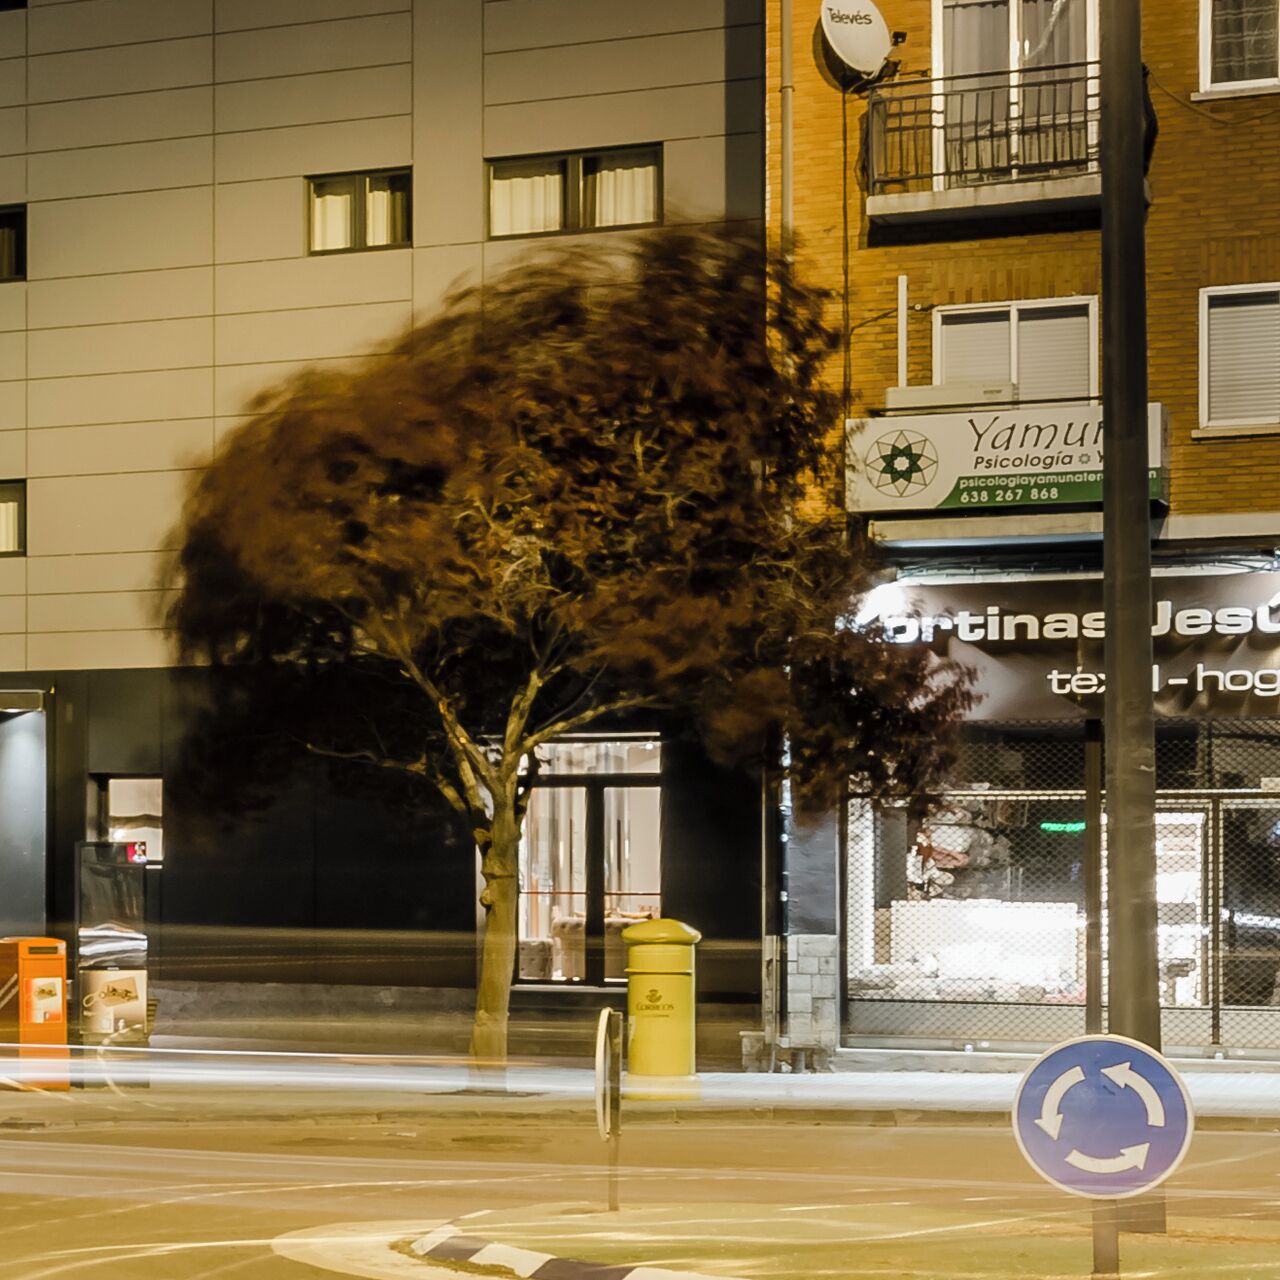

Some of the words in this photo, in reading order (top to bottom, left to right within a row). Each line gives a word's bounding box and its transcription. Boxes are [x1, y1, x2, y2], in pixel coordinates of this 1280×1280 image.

[826, 7, 873, 25] Televés
[973, 450, 1074, 470] Psicología
[960, 490, 989, 503] 638
[995, 489, 1023, 502] 267
[1030, 487, 1059, 500] 868
[865, 605, 1106, 643] ortinas
[1046, 664, 1159, 694] tel
